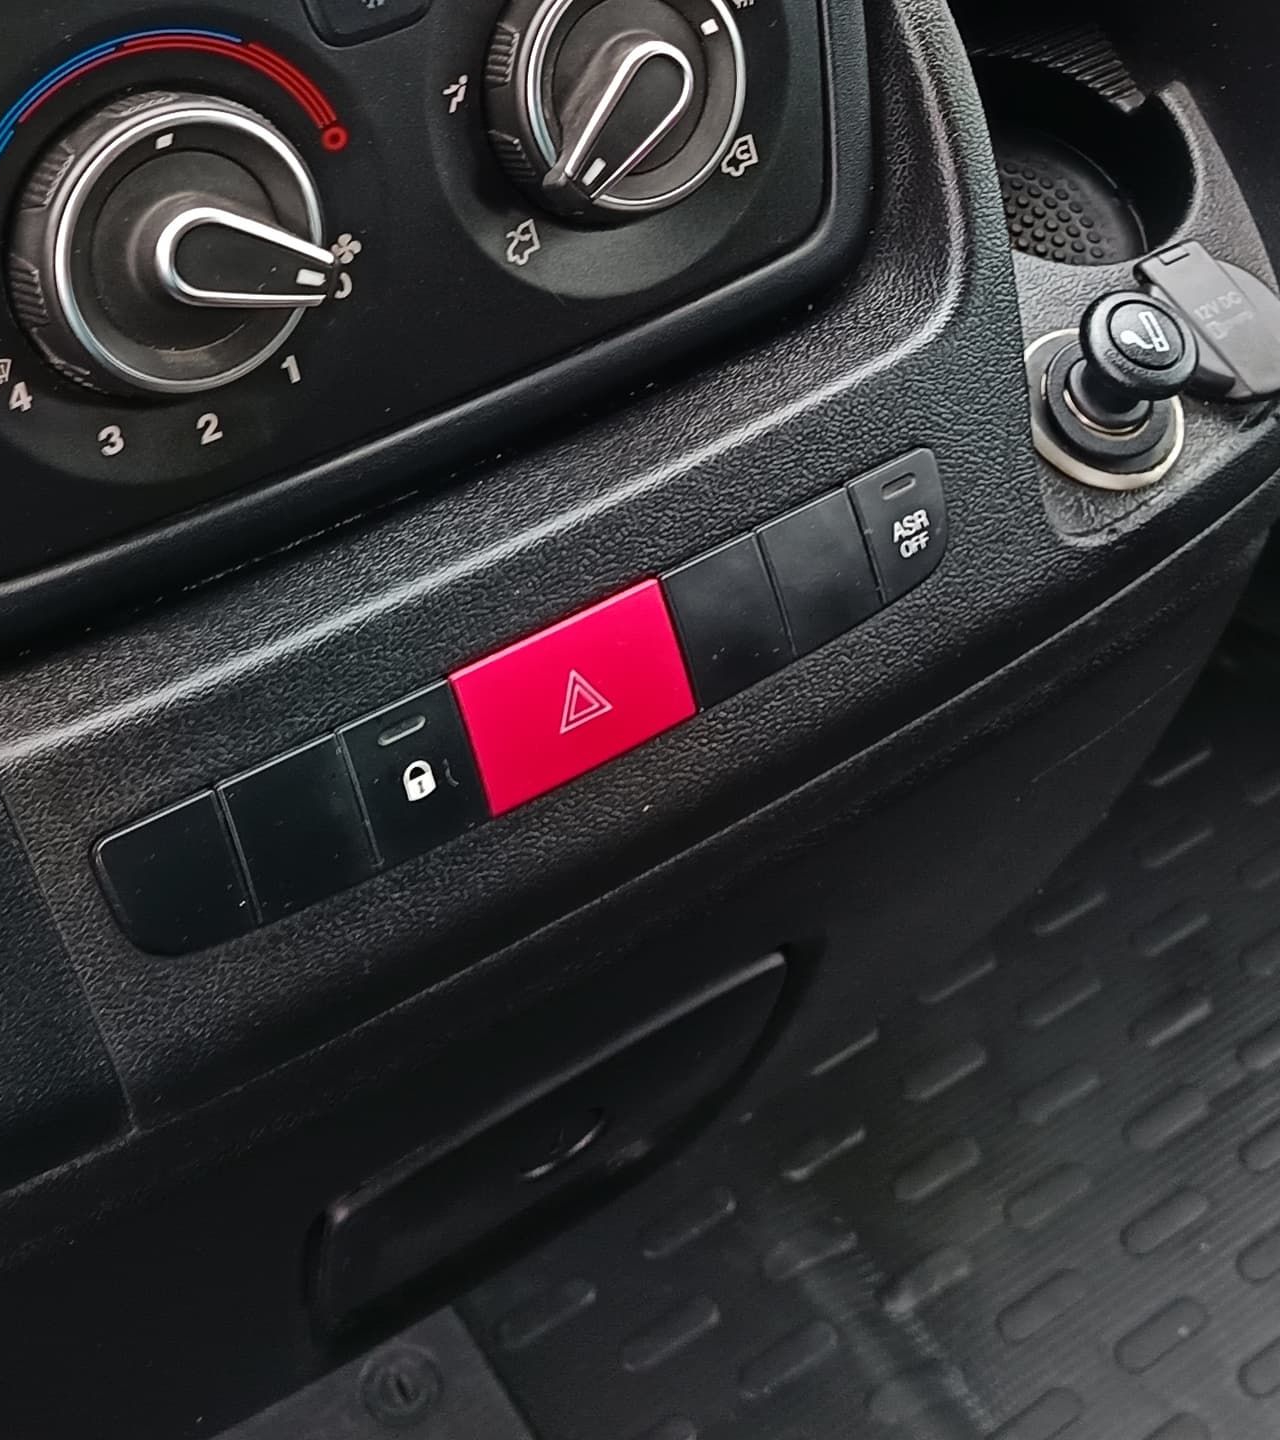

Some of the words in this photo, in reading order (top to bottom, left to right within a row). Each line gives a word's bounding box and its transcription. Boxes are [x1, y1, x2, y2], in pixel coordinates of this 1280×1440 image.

[280, 354, 302, 384] 1
[6, 380, 34, 413] 4
[98, 425, 125, 457] 3
[197, 412, 224, 447] 2
[892, 509, 930, 544] ASR
[900, 530, 930, 558] OFF
